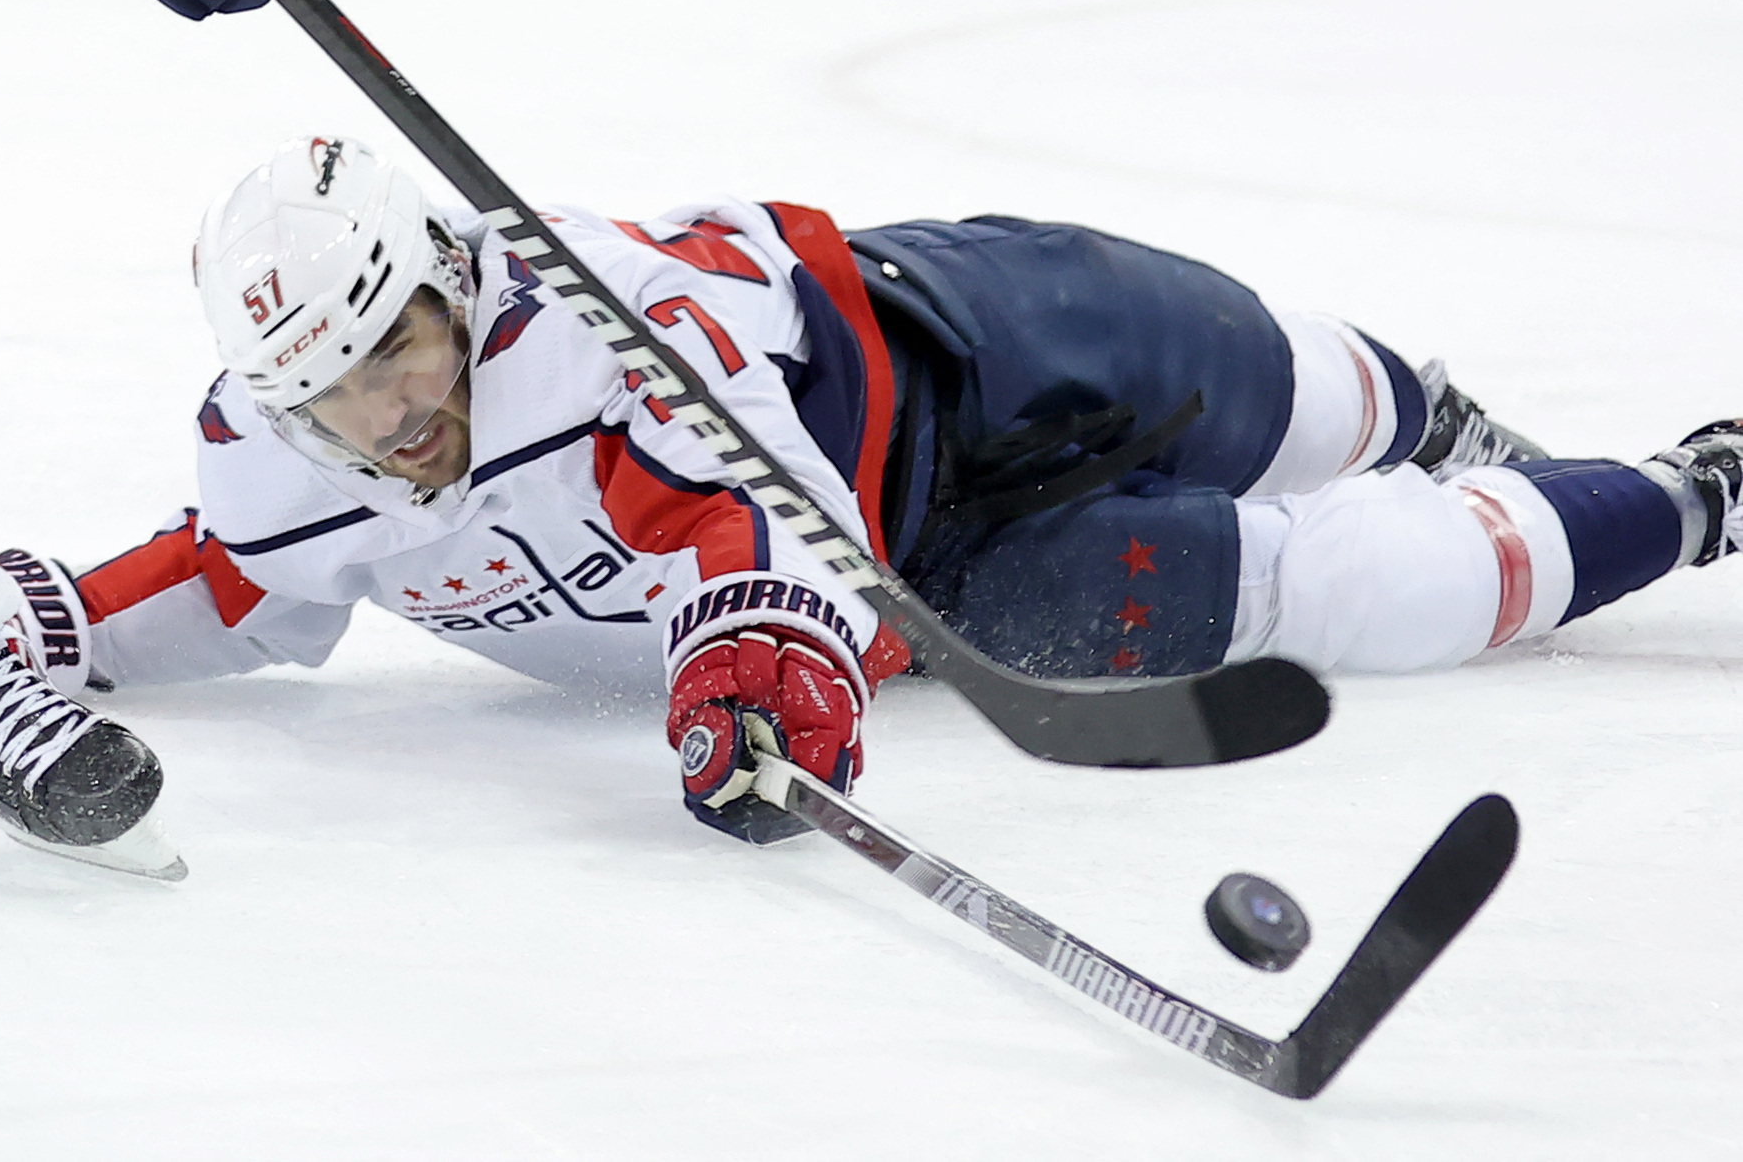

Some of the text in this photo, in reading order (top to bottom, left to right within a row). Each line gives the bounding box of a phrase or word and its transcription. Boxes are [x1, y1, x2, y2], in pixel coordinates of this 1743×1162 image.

[243, 268, 284, 326] 57
[275, 317, 329, 367] CCM
[798, 669, 831, 715] COVERT
[1046, 939, 1218, 1055] WARRIOR
